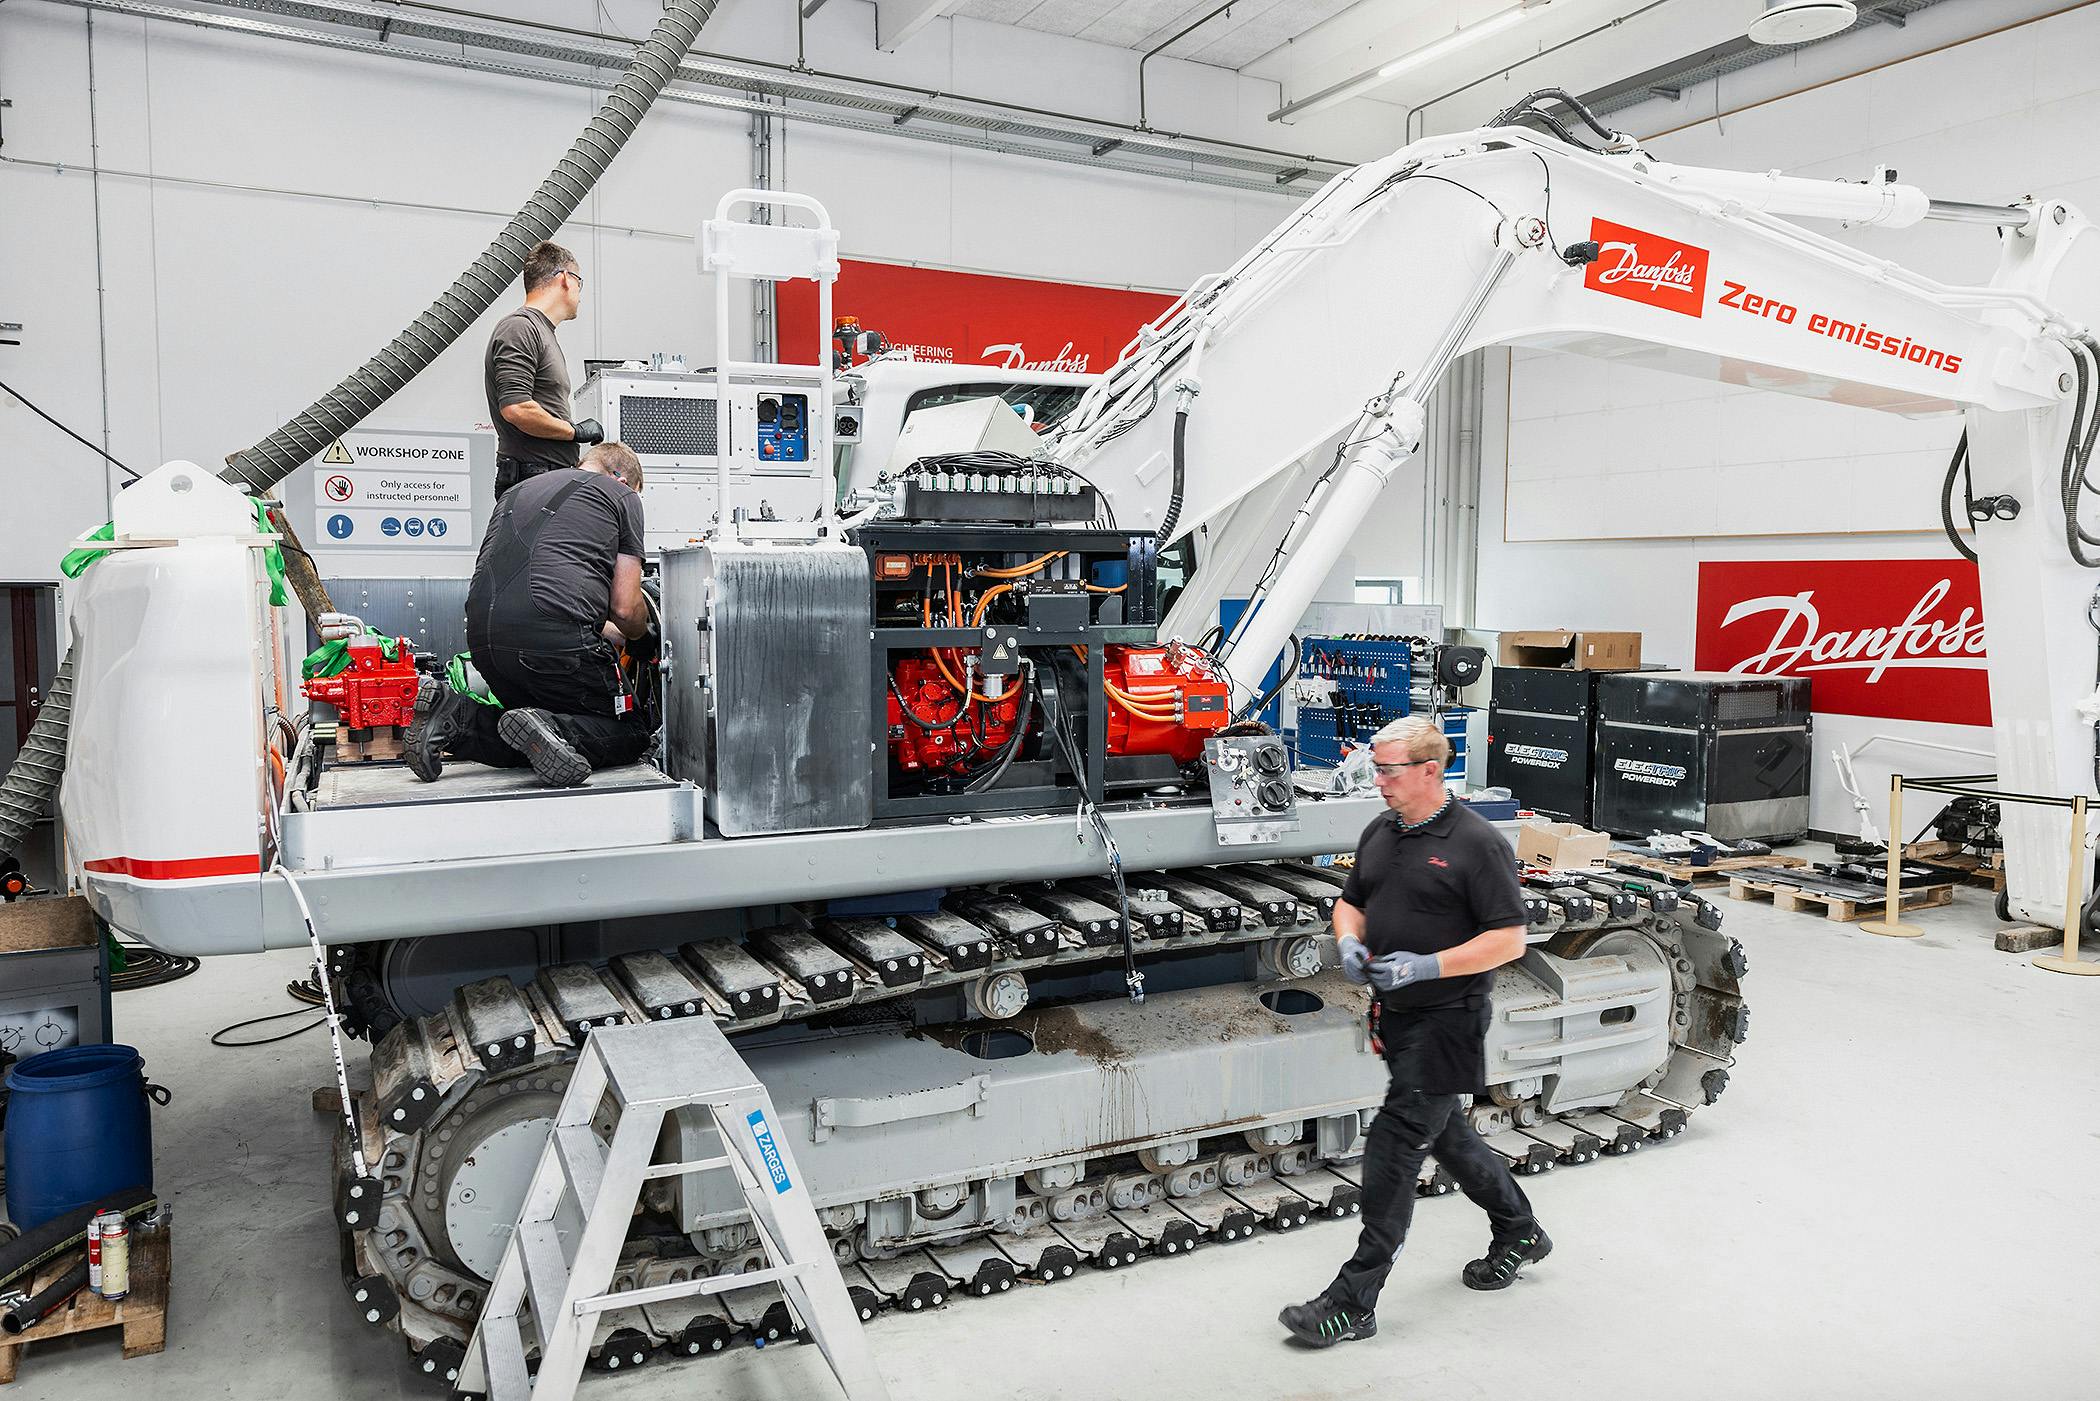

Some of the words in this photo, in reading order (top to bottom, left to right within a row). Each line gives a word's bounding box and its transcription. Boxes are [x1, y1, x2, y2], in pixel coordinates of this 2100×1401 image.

[1599, 241, 1696, 293] Danfoss
[1718, 280, 1798, 325] Zero
[1807, 313, 1963, 374] emissions
[357, 446, 429, 459] WORKSHOP
[432, 449, 464, 460] ZONE
[380, 479, 402, 490] Only
[404, 481, 431, 490] access
[433, 481, 446, 490] for
[366, 492, 412, 501] instructed
[413, 493, 460, 503] personnel!
[1504, 742, 1569, 763] ELECTRIC
[1511, 756, 1562, 770] POWERBOX
[1614, 757, 1687, 780] ELECTRIC
[1621, 772, 1678, 787] POWERBOX
[758, 1134, 786, 1184] ZARGES
